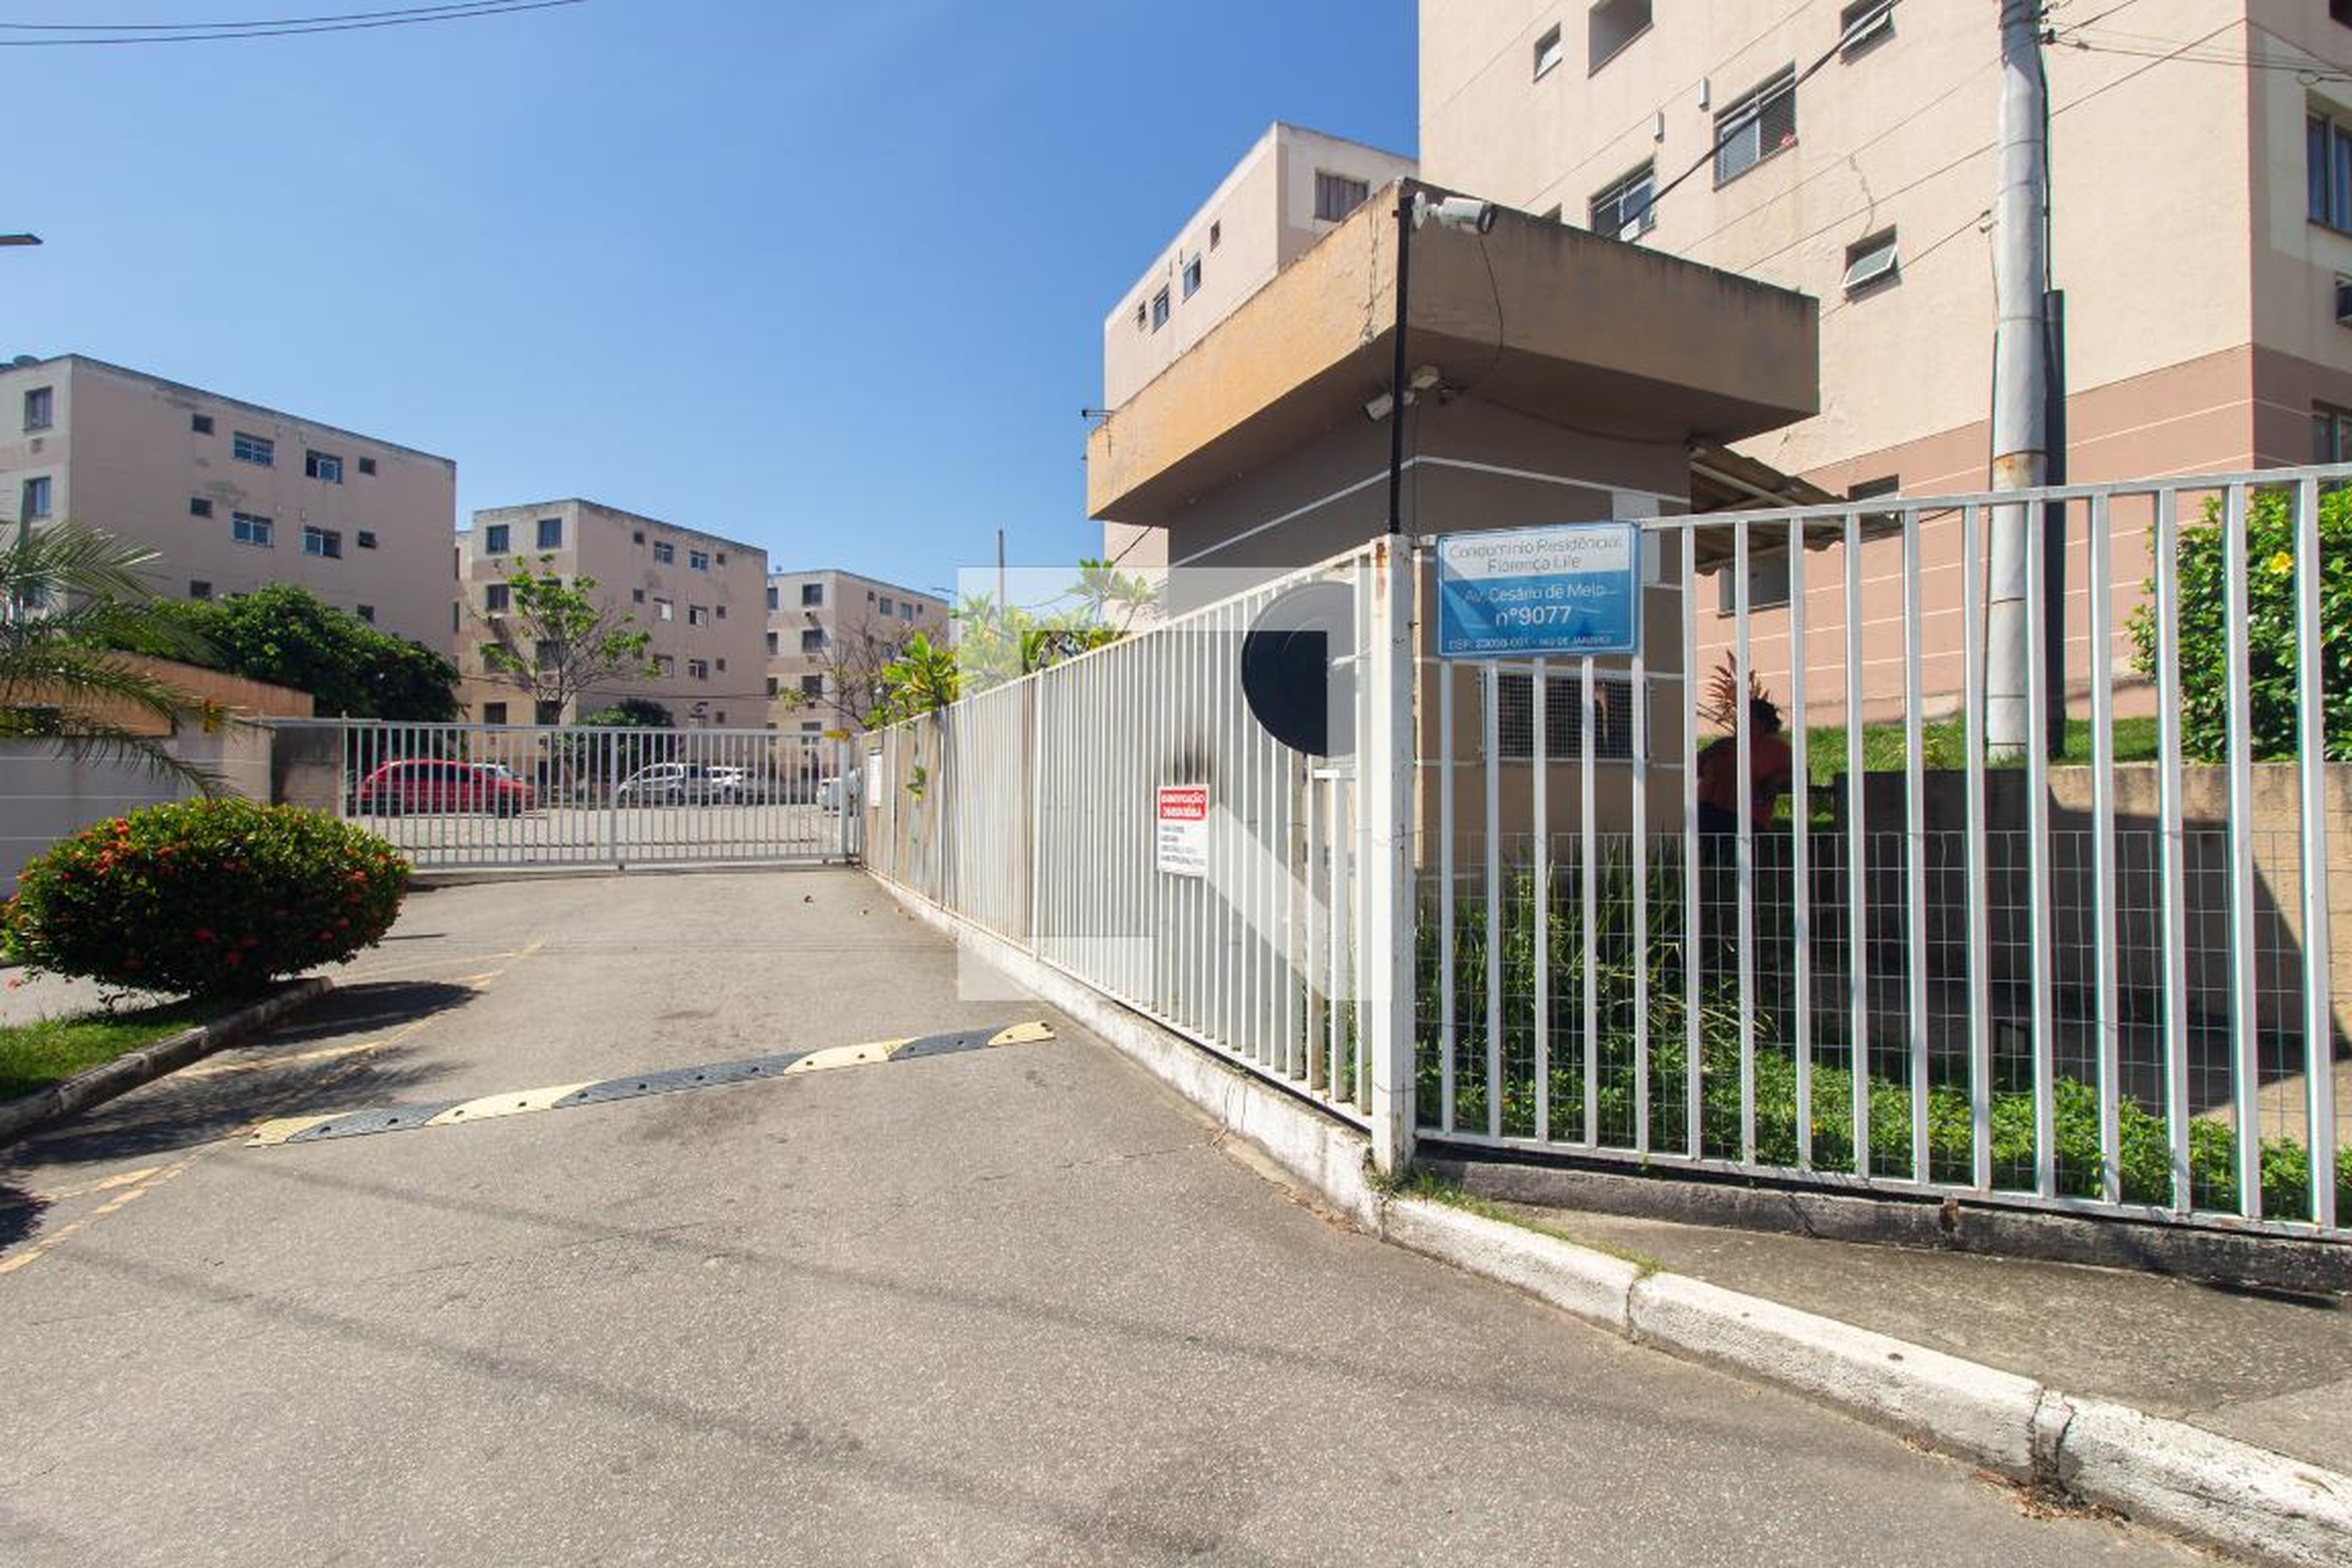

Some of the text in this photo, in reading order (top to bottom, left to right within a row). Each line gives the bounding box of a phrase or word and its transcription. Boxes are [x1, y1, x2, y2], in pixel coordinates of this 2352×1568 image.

[1488, 586, 1542, 603] Cesário
[1545, 586, 1562, 600] de
[1568, 582, 1605, 598] Melo
